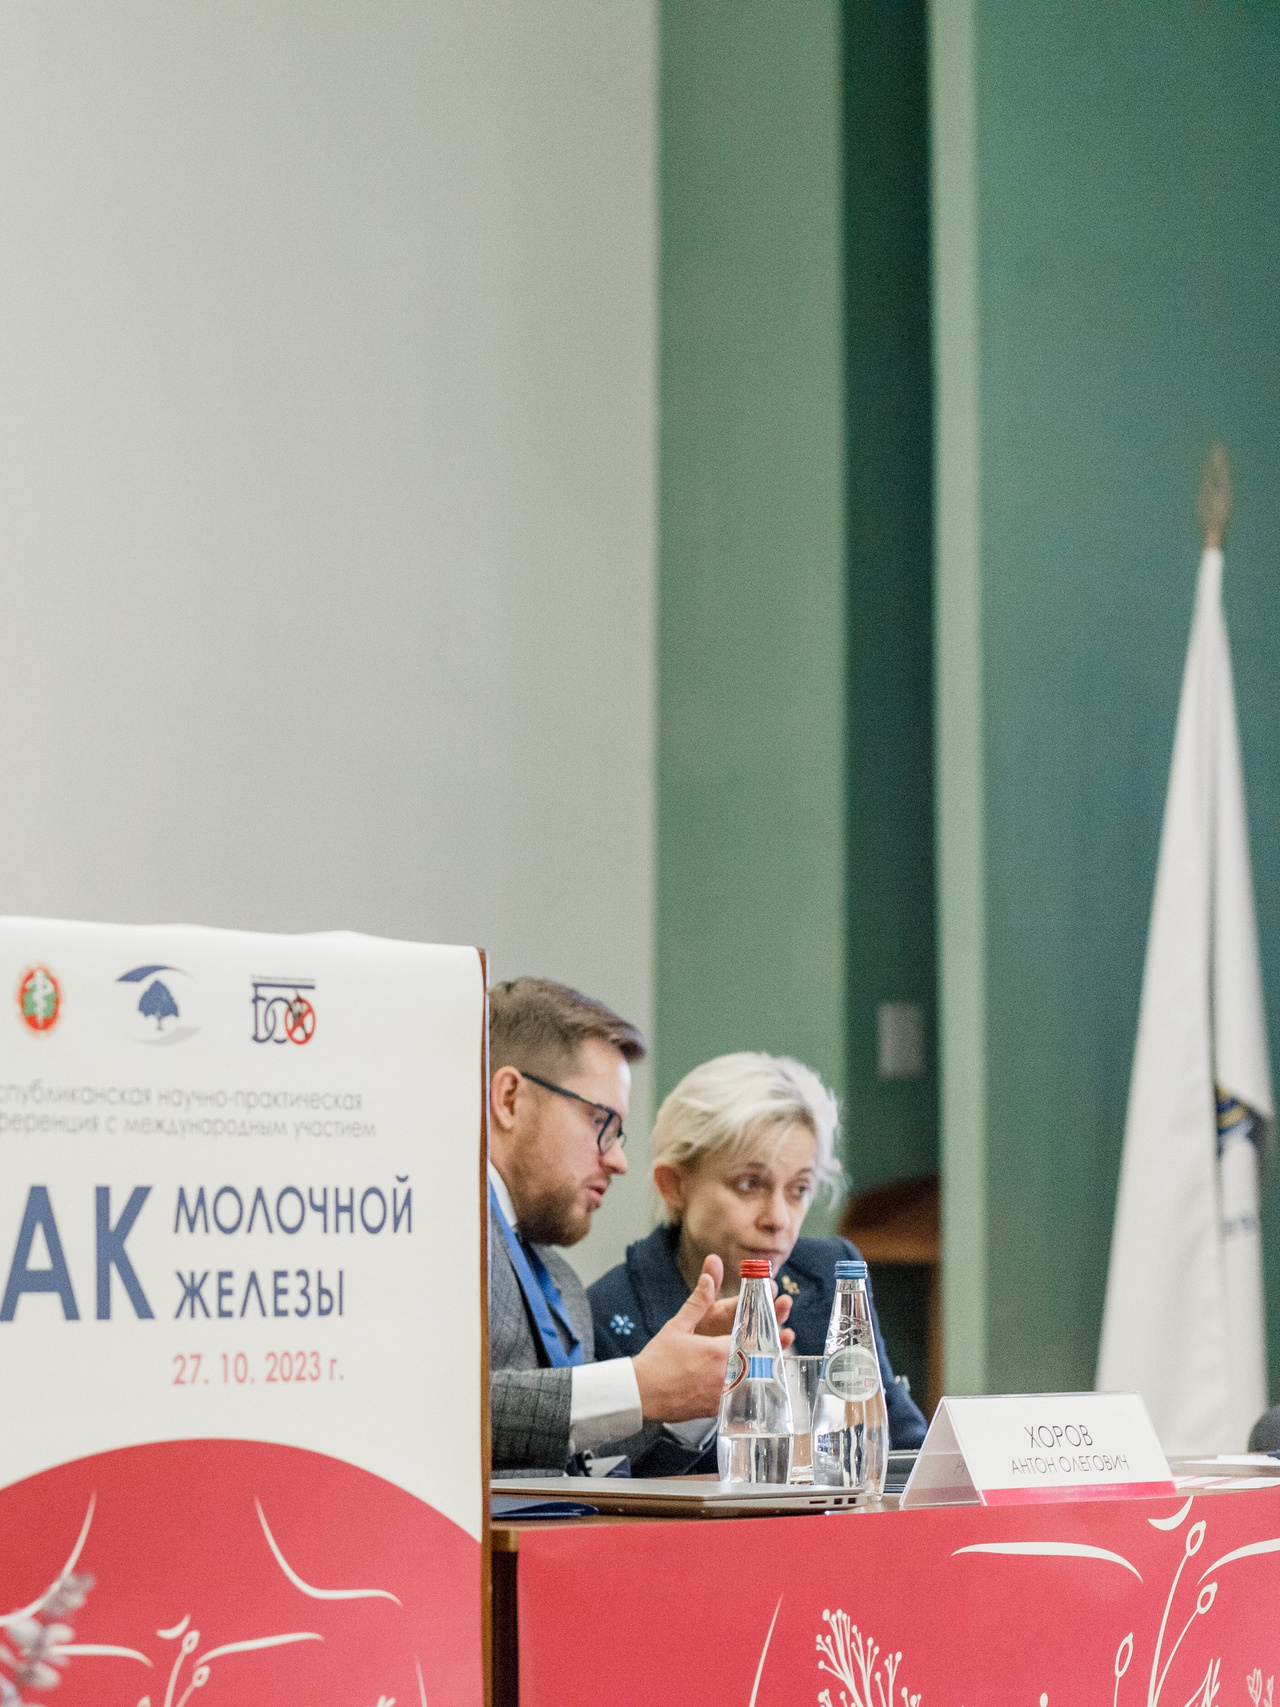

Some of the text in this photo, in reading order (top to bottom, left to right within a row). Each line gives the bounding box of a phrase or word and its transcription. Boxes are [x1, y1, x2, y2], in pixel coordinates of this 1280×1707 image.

[157, 1085, 362, 1111] научно-практическая
[105, 1115, 118, 1135] с
[124, 1115, 287, 1139] международным
[293, 1119, 377, 1141] участием
[173, 1175, 414, 1236] МОЛОЧНОЙ
[174, 1268, 345, 1320] ЖЕЛЕЗЫ
[173, 1350, 344, 1387] 27. 10. 2023 г.
[1024, 1424, 1094, 1449] ХОРОВ
[1011, 1454, 1131, 1475] АНТОН ОЛЕГОВИЧ
